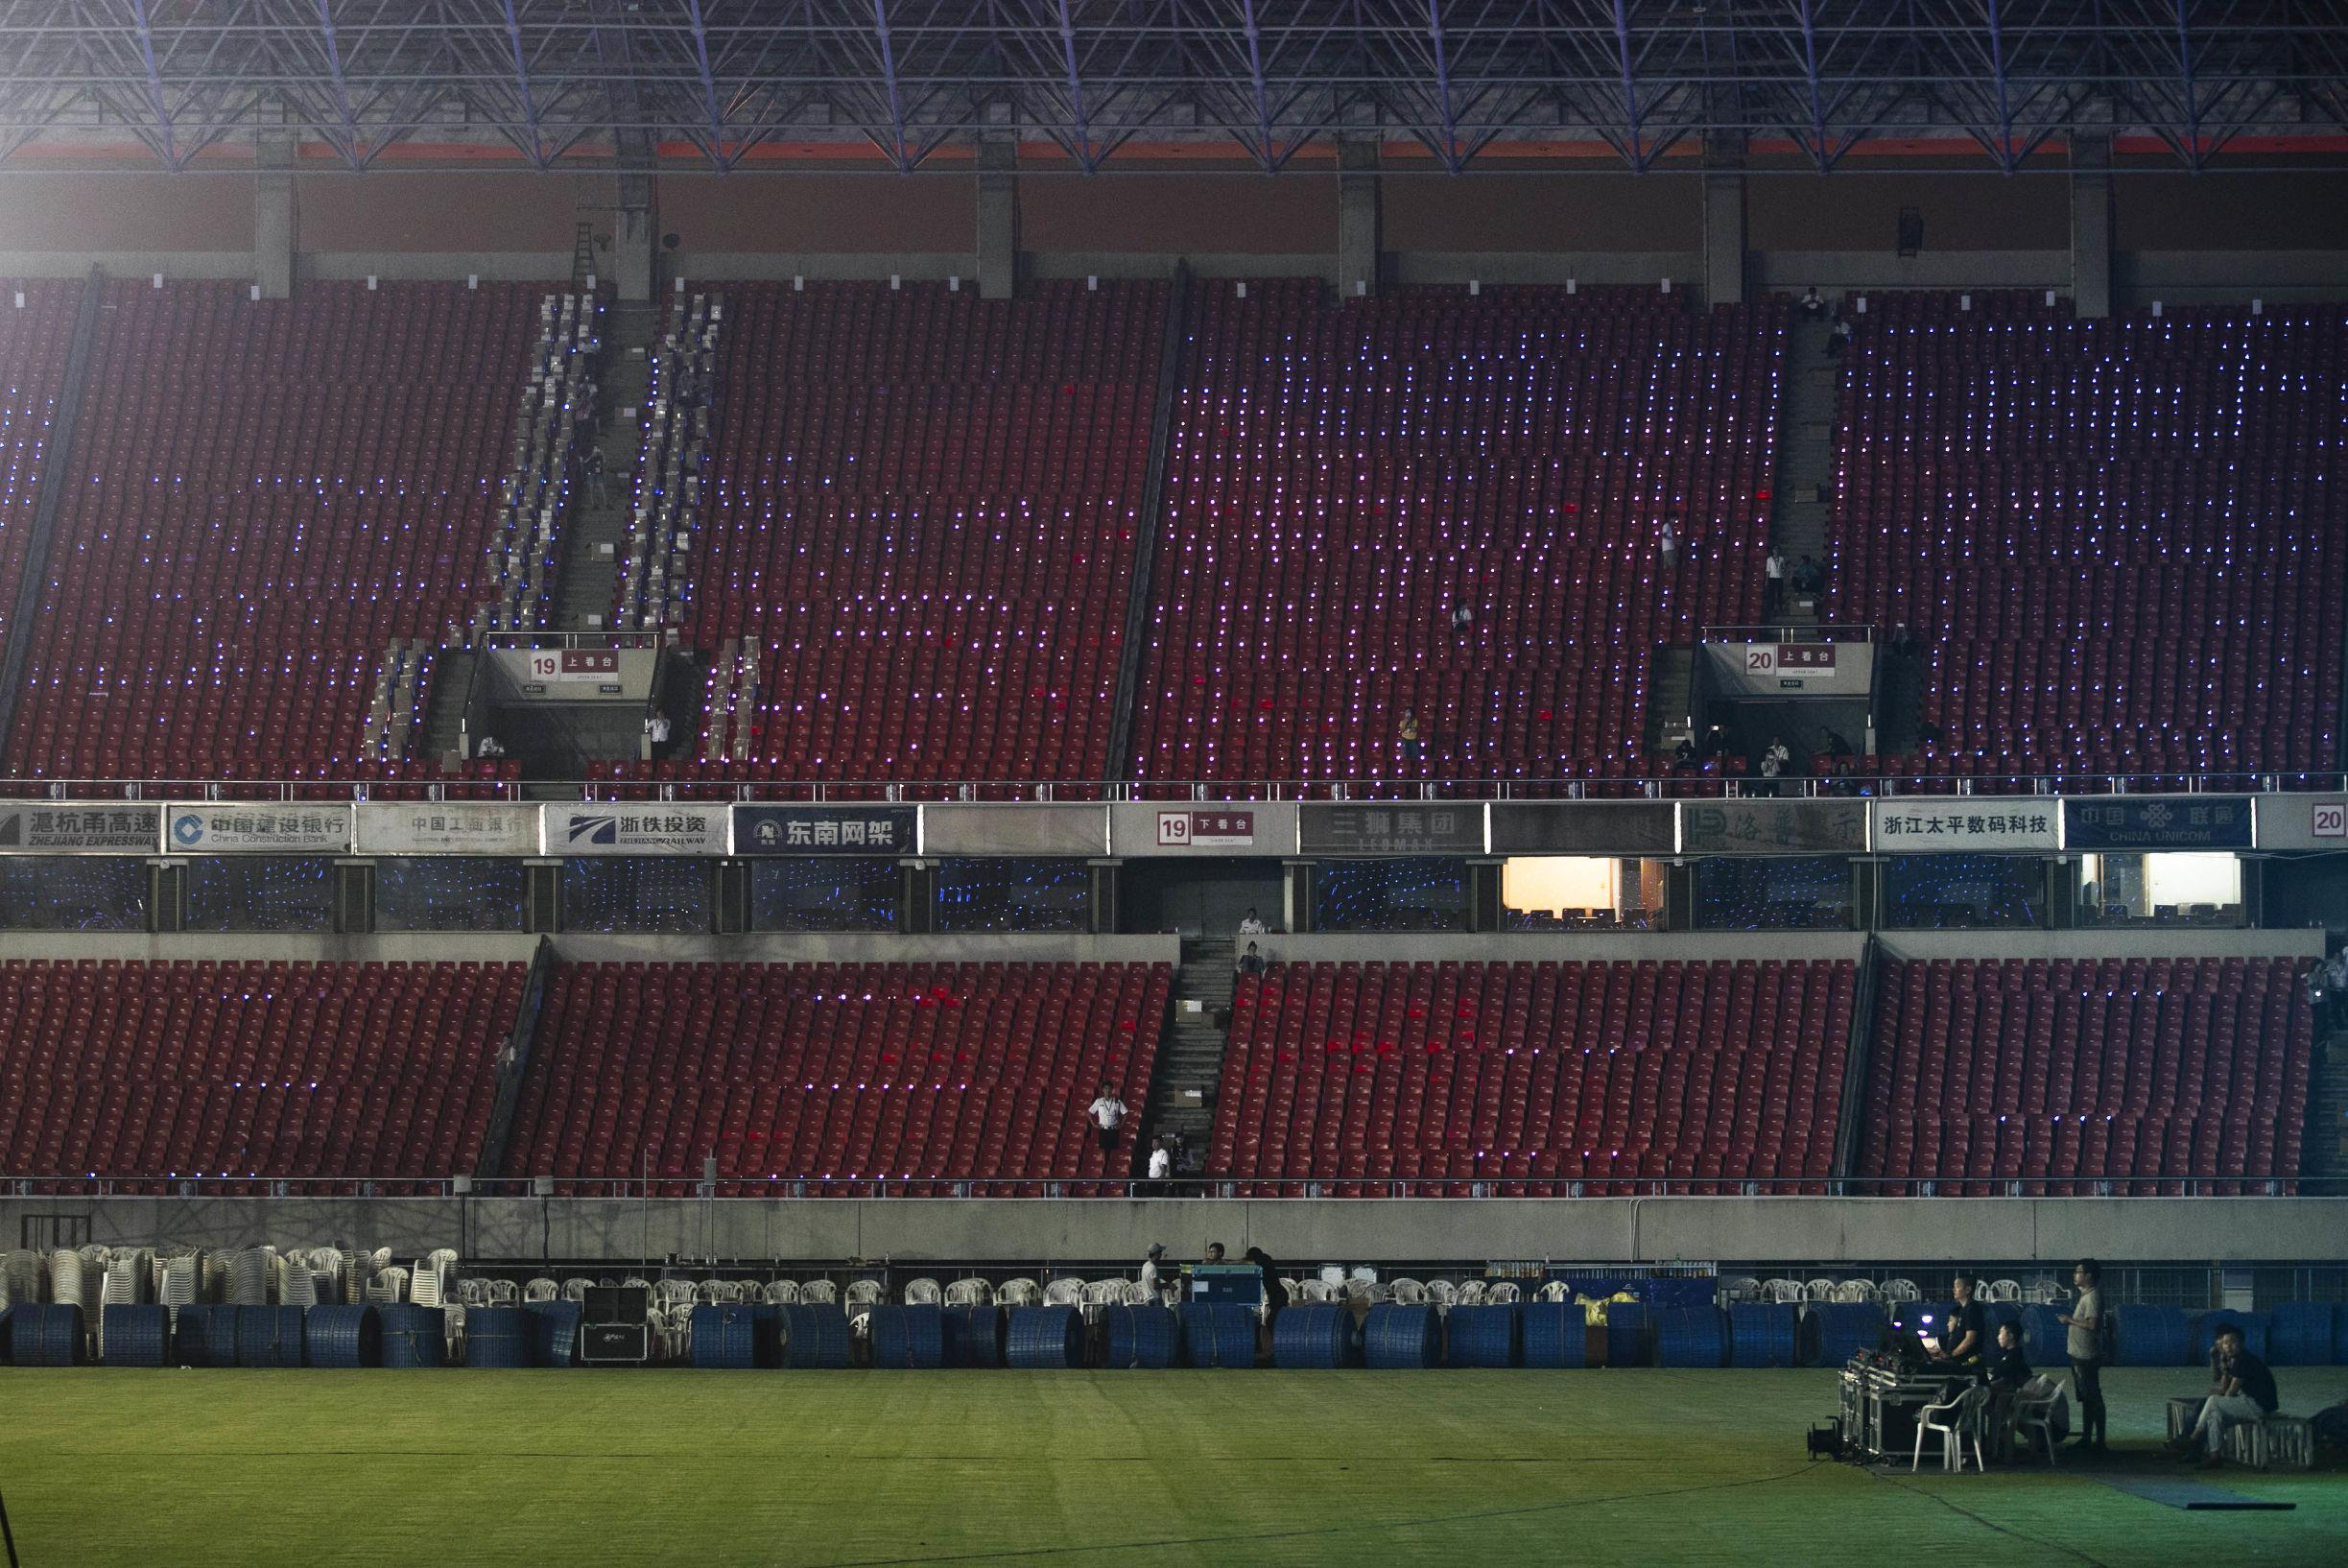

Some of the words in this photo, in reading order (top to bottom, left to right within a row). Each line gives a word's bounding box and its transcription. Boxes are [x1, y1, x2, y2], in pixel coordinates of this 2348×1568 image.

[567, 656, 612, 667] 上看台
[1748, 653, 1772, 669] 20
[1784, 652, 1829, 662] 上看台
[534, 658, 556, 675] 19
[2080, 806, 2124, 825] 中国
[2315, 811, 2342, 829] 20
[211, 815, 344, 833] 中国建设银行
[413, 816, 521, 832] 中国工商银行
[620, 816, 706, 833] 浙铁投资
[1162, 820, 1186, 837] 19
[1199, 819, 1246, 830] 下看台
[1884, 816, 2048, 834] 浙江太平数码科技
[211, 834, 238, 843] China
[242, 834, 300, 843] Construction
[303, 834, 327, 843] Bank
[787, 820, 892, 845] 东南网架
[2110, 831, 2150, 842] CHINA
[2155, 831, 2211, 842] UNICOM
[29, 836, 85, 846] ZHEJIANG
[85, 836, 158, 846] EXPRESSWAY
